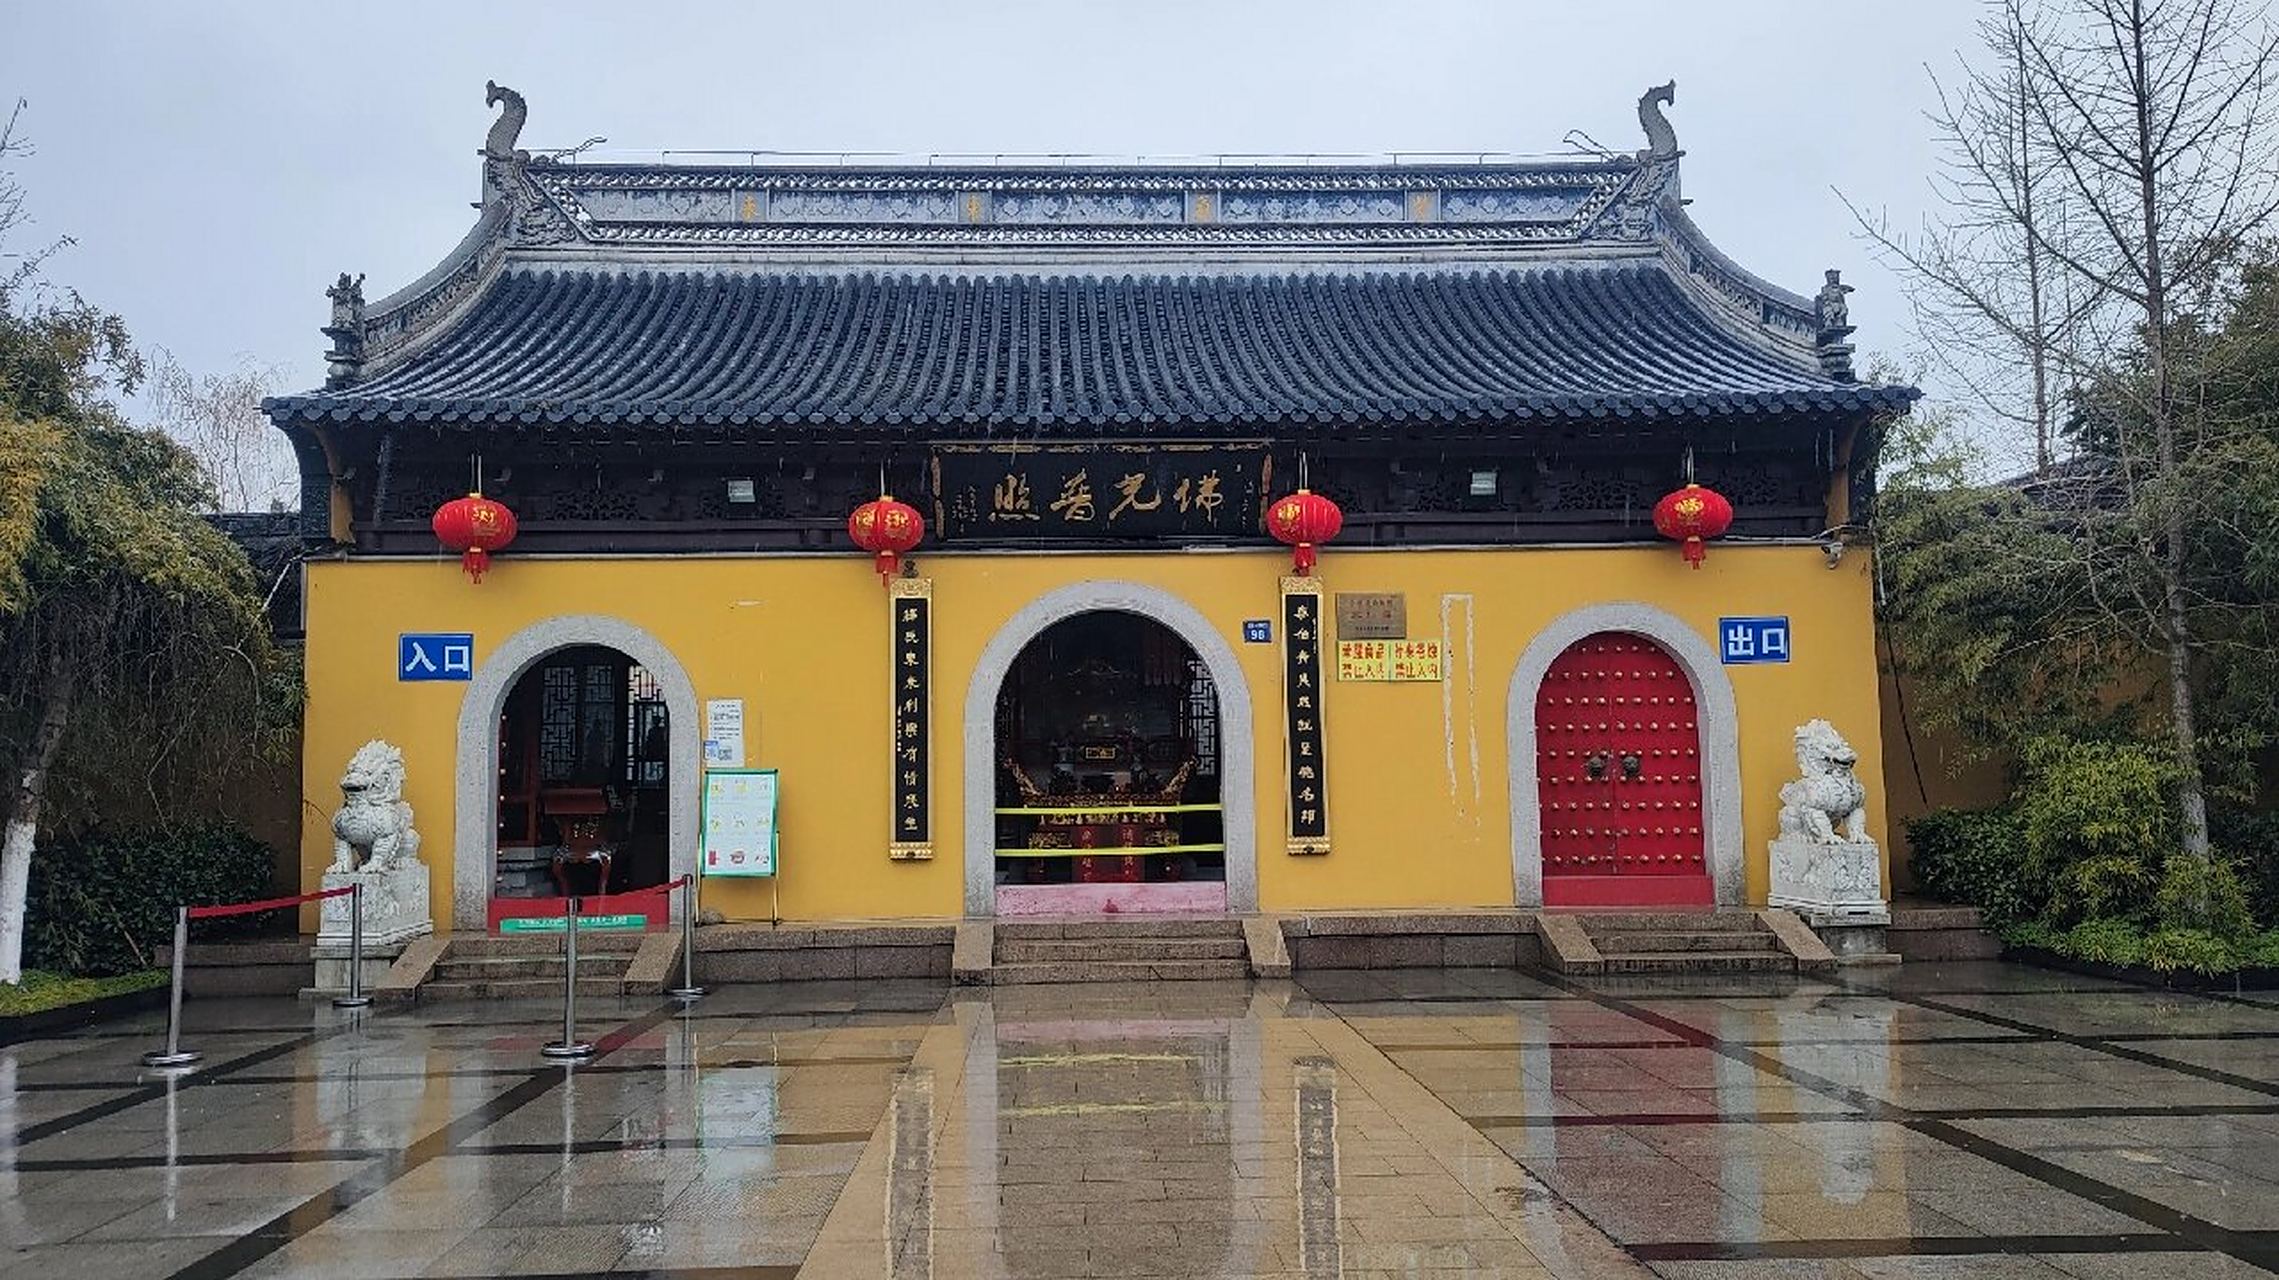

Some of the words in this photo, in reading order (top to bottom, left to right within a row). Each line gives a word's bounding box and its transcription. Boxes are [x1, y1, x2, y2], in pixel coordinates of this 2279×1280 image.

[989, 467, 1225, 523] 佛光普照
[1728, 624, 1785, 656] 出口
[406, 643, 470, 672] 入口
[1395, 662, 1438, 679] 禁止入内
